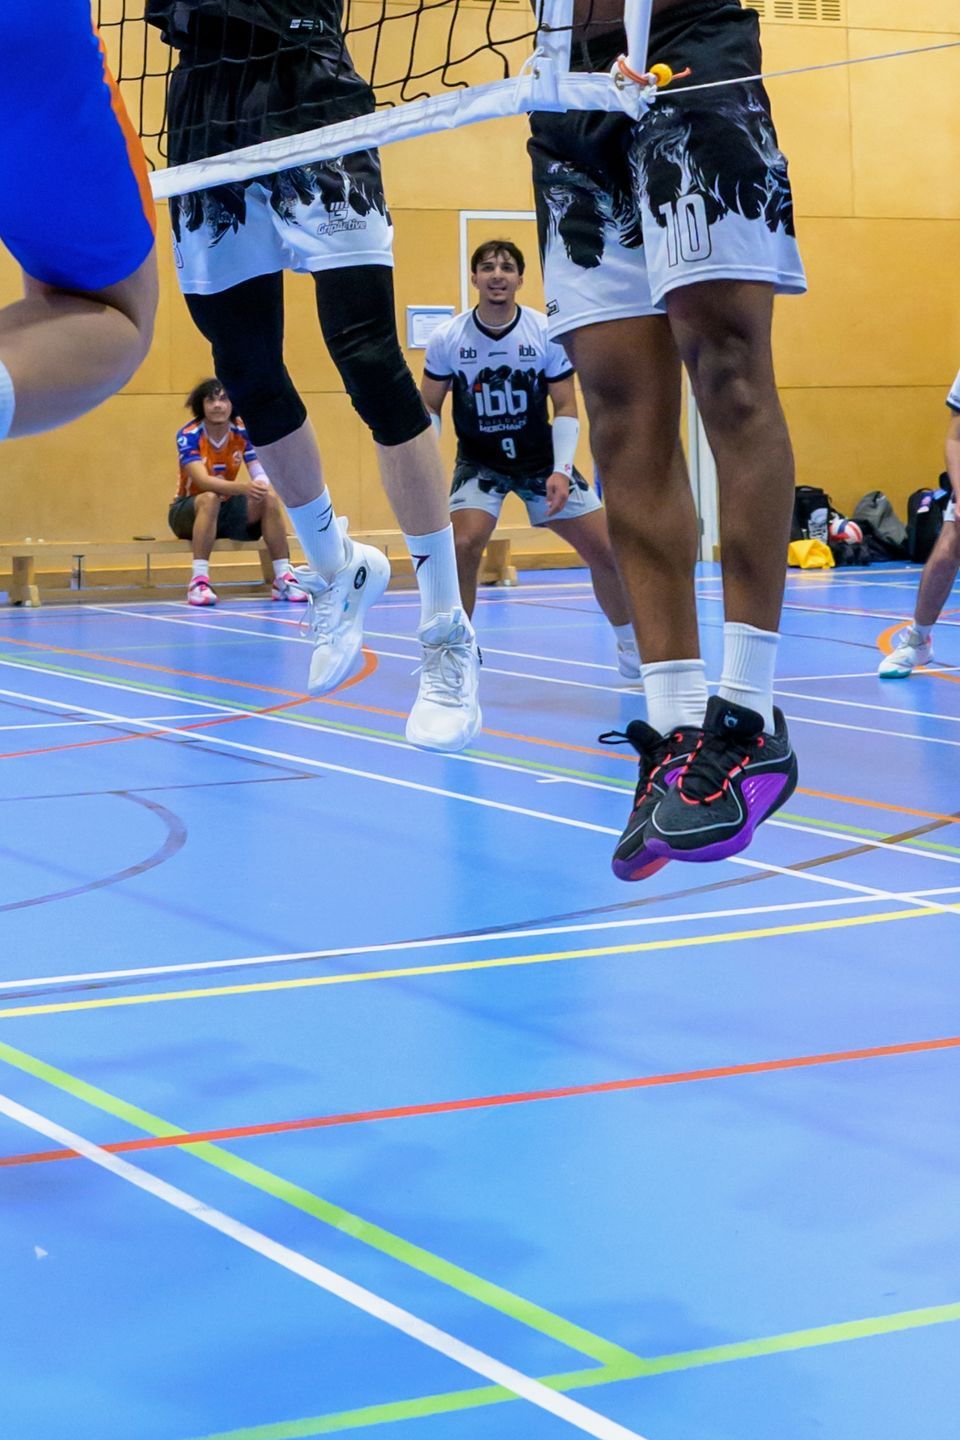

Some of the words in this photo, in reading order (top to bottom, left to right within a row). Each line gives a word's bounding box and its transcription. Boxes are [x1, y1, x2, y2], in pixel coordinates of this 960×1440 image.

[658, 193, 712, 268] 10
[460, 346, 477, 359] ibb
[519, 343, 537, 357] ibb
[474, 380, 528, 417] ibb
[501, 437, 517, 459] 9
